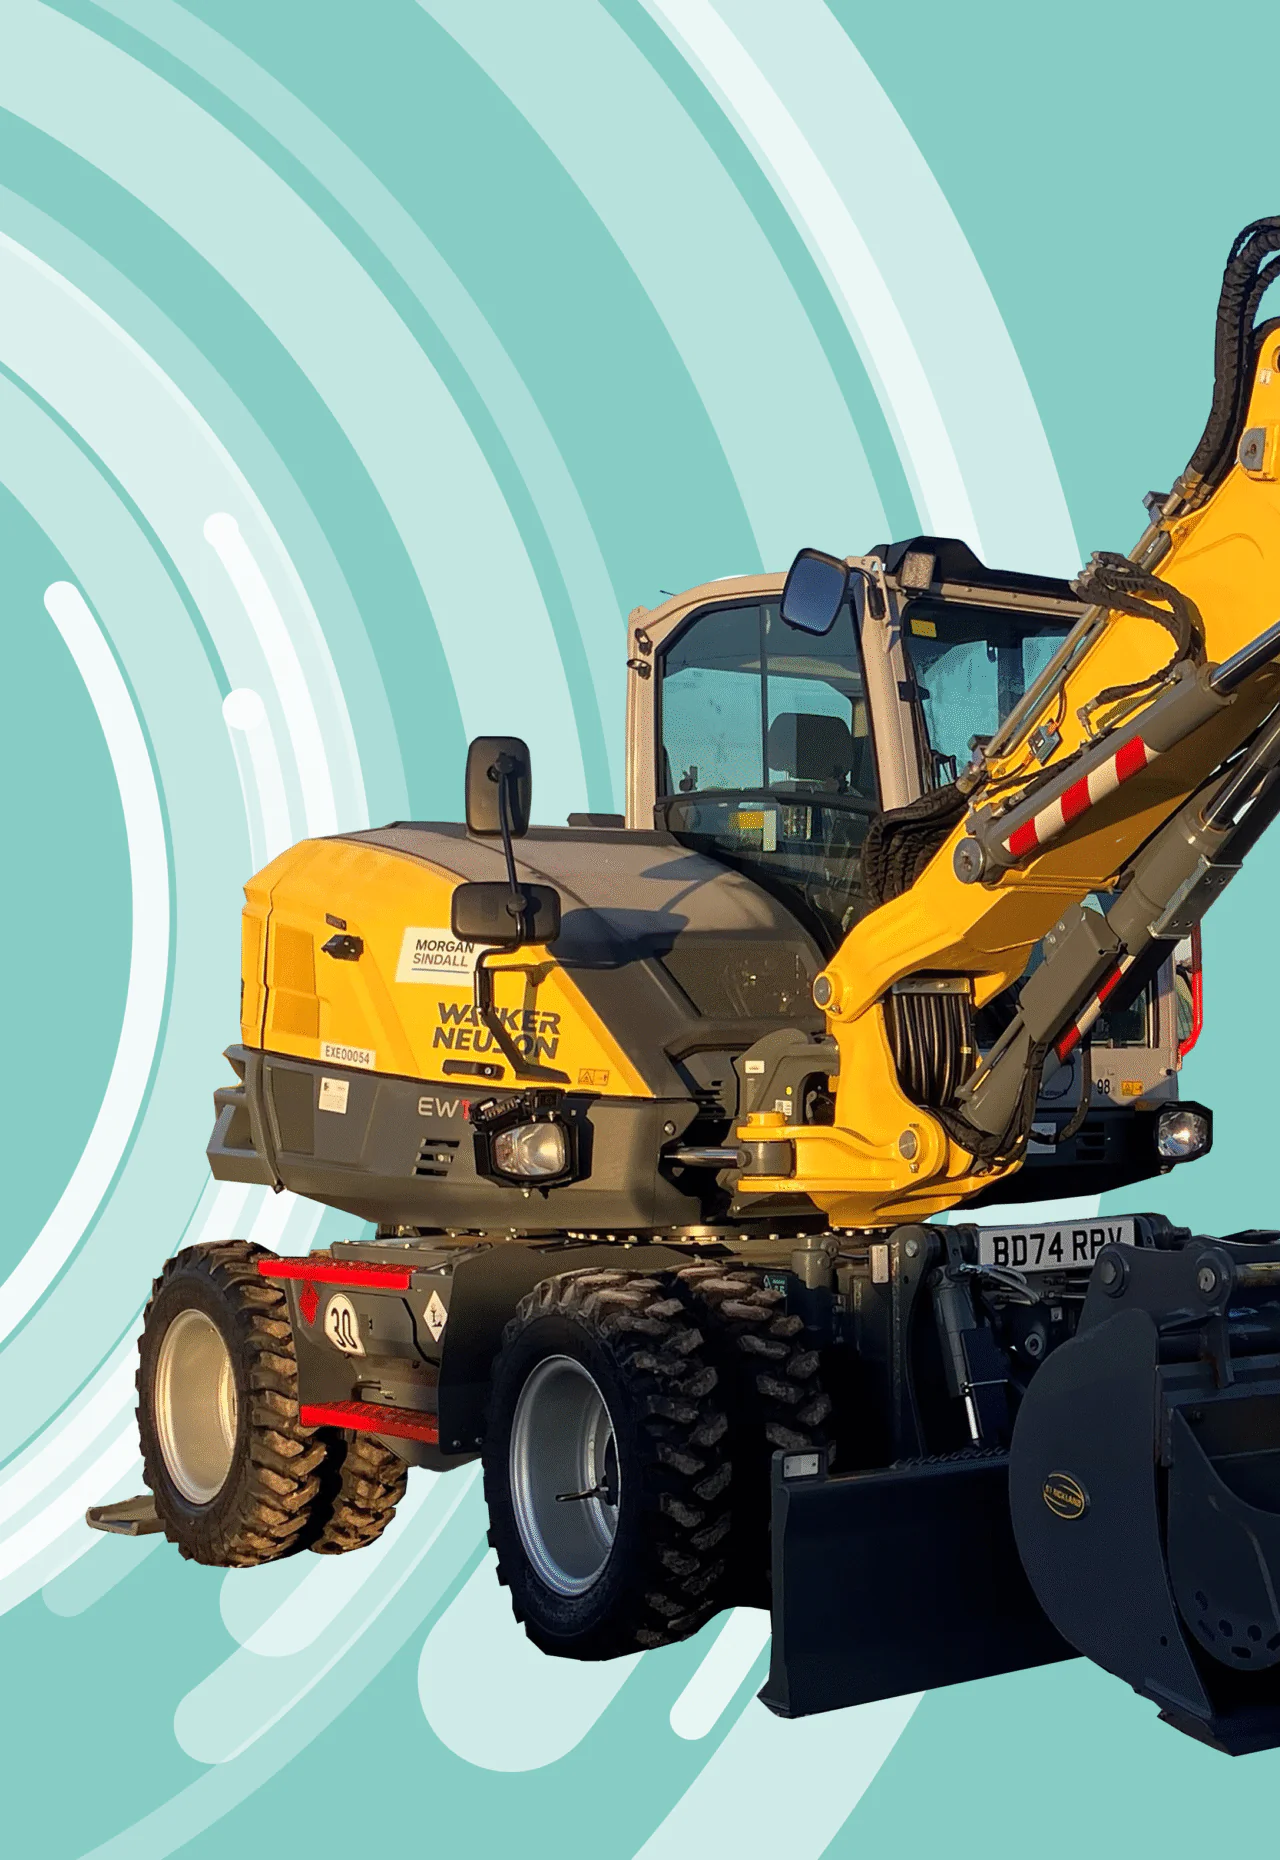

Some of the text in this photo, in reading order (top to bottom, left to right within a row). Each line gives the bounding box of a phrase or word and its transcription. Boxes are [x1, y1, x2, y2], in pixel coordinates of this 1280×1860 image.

[415, 939, 475, 953] MORGAN
[413, 953, 468, 967] SINDALL
[438, 1002, 561, 1035] WAKER
[325, 1045, 370, 1064] EXE00054
[432, 1027, 560, 1059] NEUON
[1097, 1079, 1110, 1095] 98
[993, 1231, 1063, 1266] BD74
[331, 1307, 357, 1349] 30
